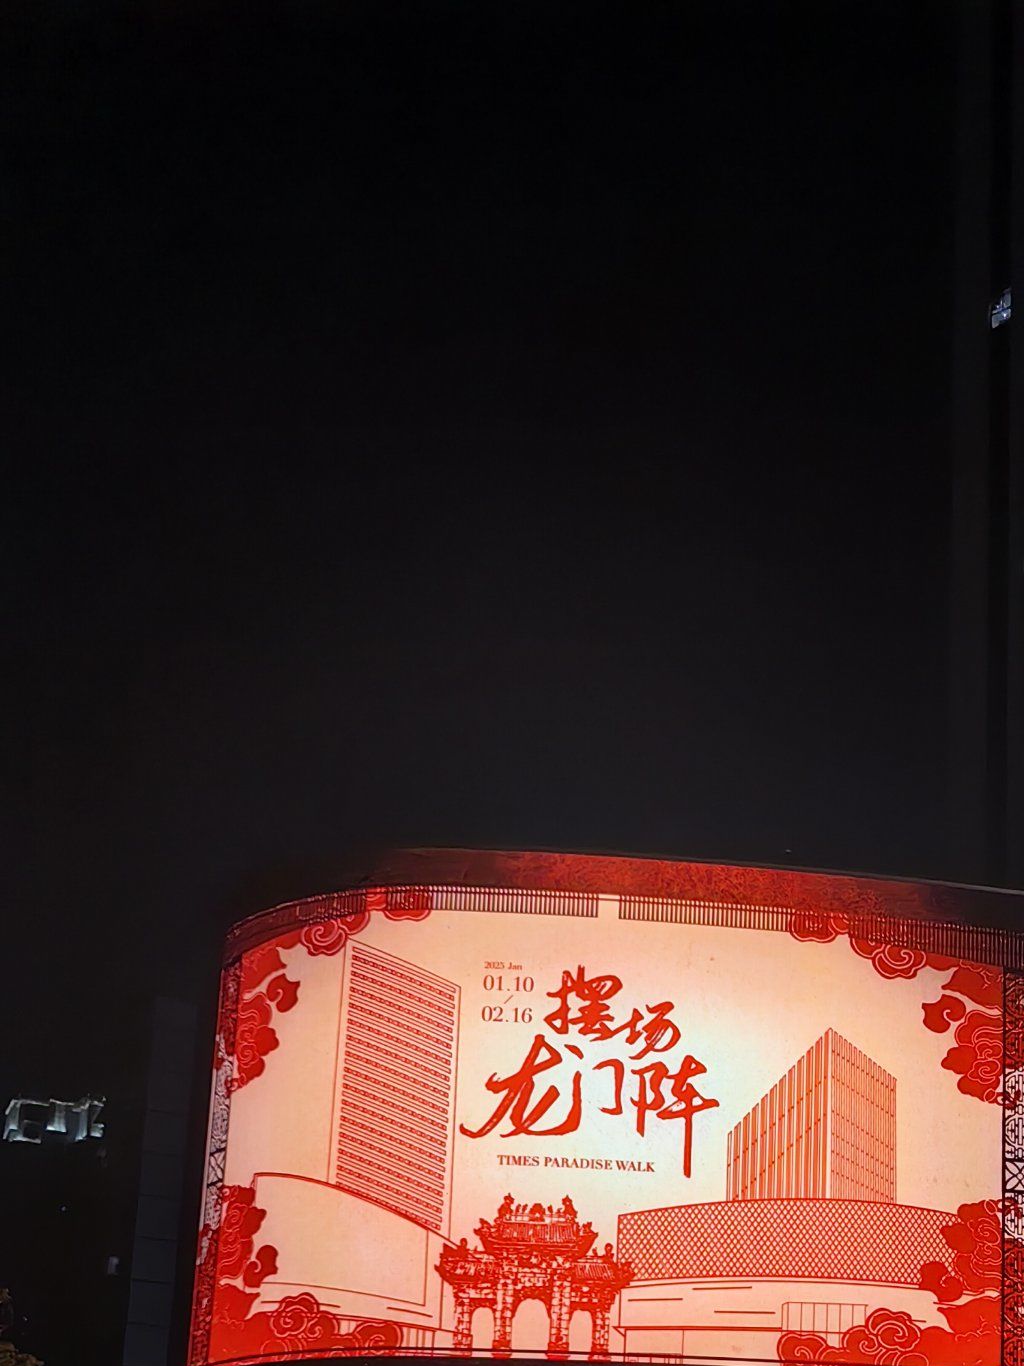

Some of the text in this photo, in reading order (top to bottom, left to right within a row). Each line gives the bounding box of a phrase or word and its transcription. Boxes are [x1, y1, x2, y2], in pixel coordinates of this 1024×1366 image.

[482, 974, 535, 993] 01.10
[481, 1005, 533, 1024] 02.16
[497, 1154, 656, 1173] TIMES PARADISE WALK
